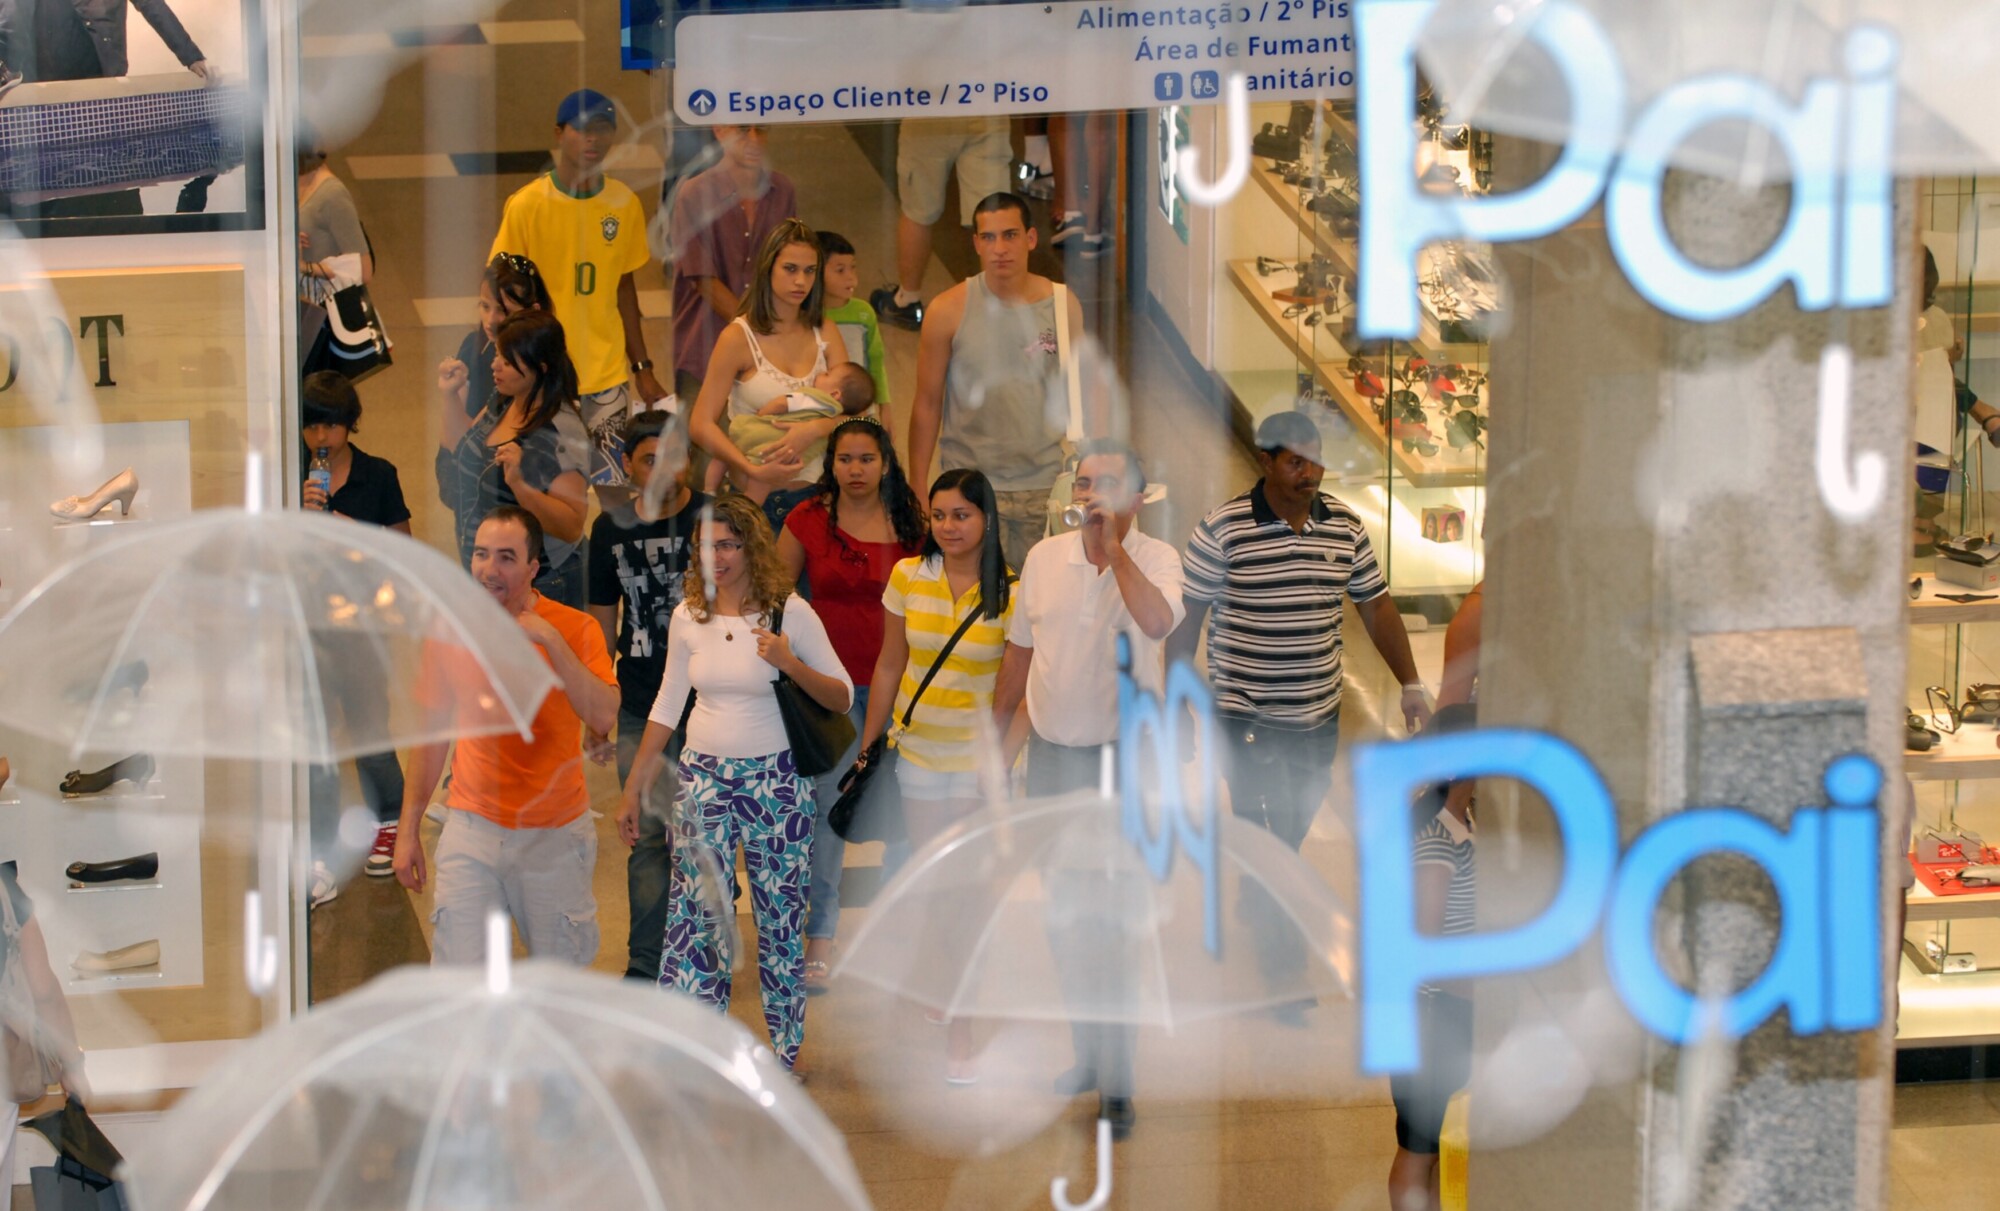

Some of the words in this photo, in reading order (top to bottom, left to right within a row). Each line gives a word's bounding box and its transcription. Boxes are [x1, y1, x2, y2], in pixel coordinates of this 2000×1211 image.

[1076, 4, 1251, 30] Alimentação
[1259, 2, 1268, 22] /
[1312, 0, 1350, 19] Pis
[1135, 36, 1198, 61] Área
[1206, 37, 1240, 58] de
[1248, 33, 1353, 56] Fumant
[1246, 66, 1354, 91] anitário
[728, 91, 825, 116] Espaço
[833, 86, 931, 109] Cliente
[939, 84, 950, 105] /
[993, 81, 1049, 103] Piso
[1354, 0, 1897, 340] Pai
[574, 261, 596, 297] 10
[1354, 727, 1883, 1075] Pai
